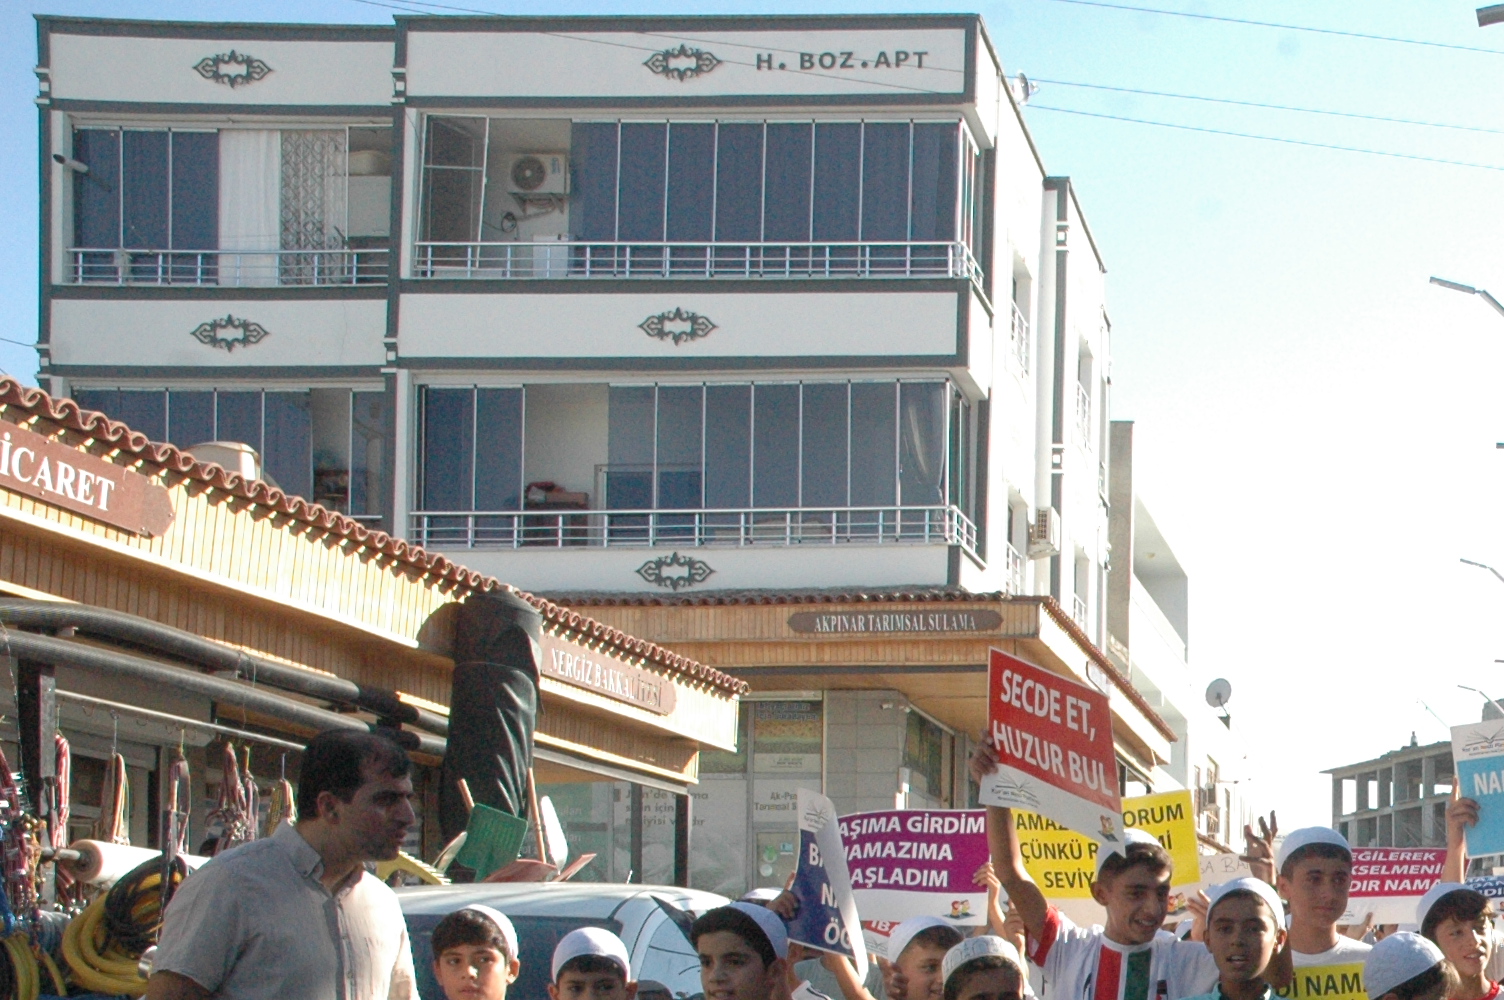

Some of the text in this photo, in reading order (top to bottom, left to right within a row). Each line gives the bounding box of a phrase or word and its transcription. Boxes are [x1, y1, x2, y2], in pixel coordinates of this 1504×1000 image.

[814, 613, 977, 632] AKPINAR TARIMSAL SULAMA
[550, 647, 593, 684] NERGİZ
[1001, 669, 1096, 742] SECDE ET,
[993, 719, 1114, 798] HUZUR BUL
[839, 816, 901, 840] AŞIMA
[907, 813, 985, 833] GİRDİM
[1123, 803, 1185, 827] ORUM
[844, 842, 953, 861] AMAZIMA
[1020, 839, 1081, 865] ÇÜNKÜ
[851, 867, 948, 888] AŞLADIM
[1043, 868, 1095, 888] SEVİY
[1351, 863, 1444, 875] KSELMENİ
[1349, 879, 1441, 892] DIR NAMA
[1305, 973, 1367, 996] NAM
